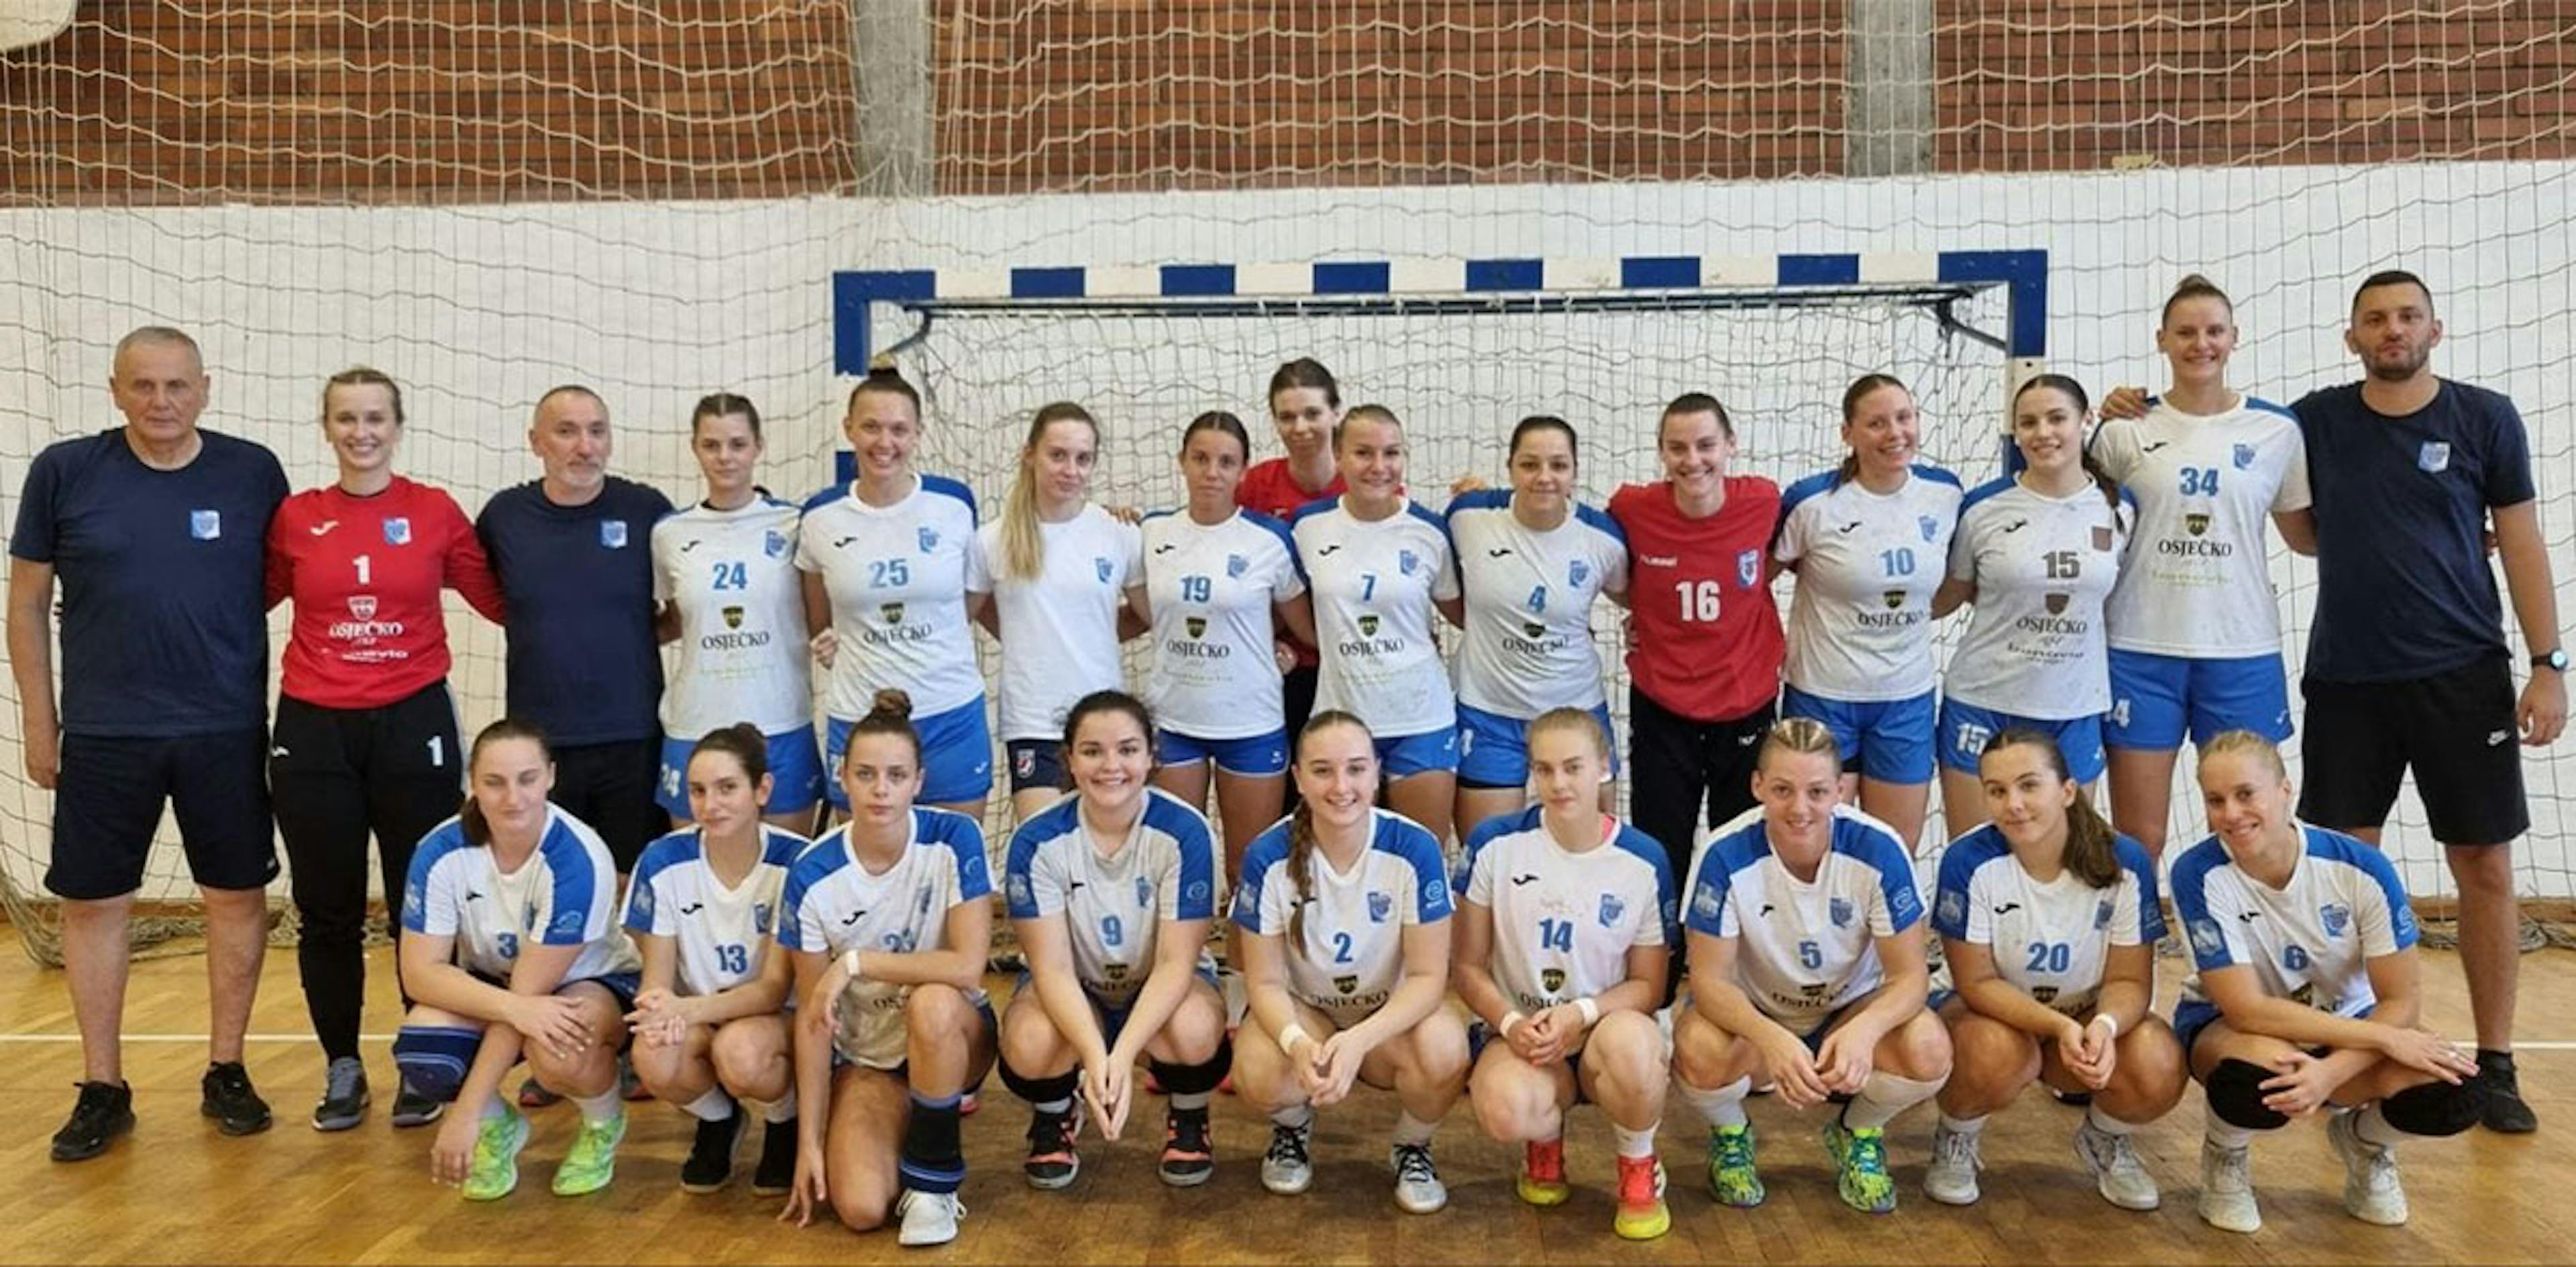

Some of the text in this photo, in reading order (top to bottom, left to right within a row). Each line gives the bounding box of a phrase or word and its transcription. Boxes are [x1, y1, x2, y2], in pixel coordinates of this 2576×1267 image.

[2180, 468, 2218, 496] 34
[352, 554, 371, 585] 1
[713, 562, 747, 589] 24
[869, 559, 908, 588] 25
[1880, 548, 1915, 576] 10
[2043, 551, 2080, 578] 15
[1181, 576, 1211, 602] 19
[1362, 575, 1375, 601] 7
[1529, 586, 1545, 611] 4
[1676, 580, 1720, 621] 16
[427, 736, 443, 766] 1
[1957, 723, 1990, 756] 15
[498, 932, 518, 958] 3
[1102, 916, 1122, 945] 9
[1540, 919, 1573, 953] 14
[715, 944, 747, 974] 13
[1333, 932, 1352, 962] 2
[1799, 941, 1822, 970] 5
[2026, 943, 2070, 972] 20
[2283, 945, 2309, 971] 6
